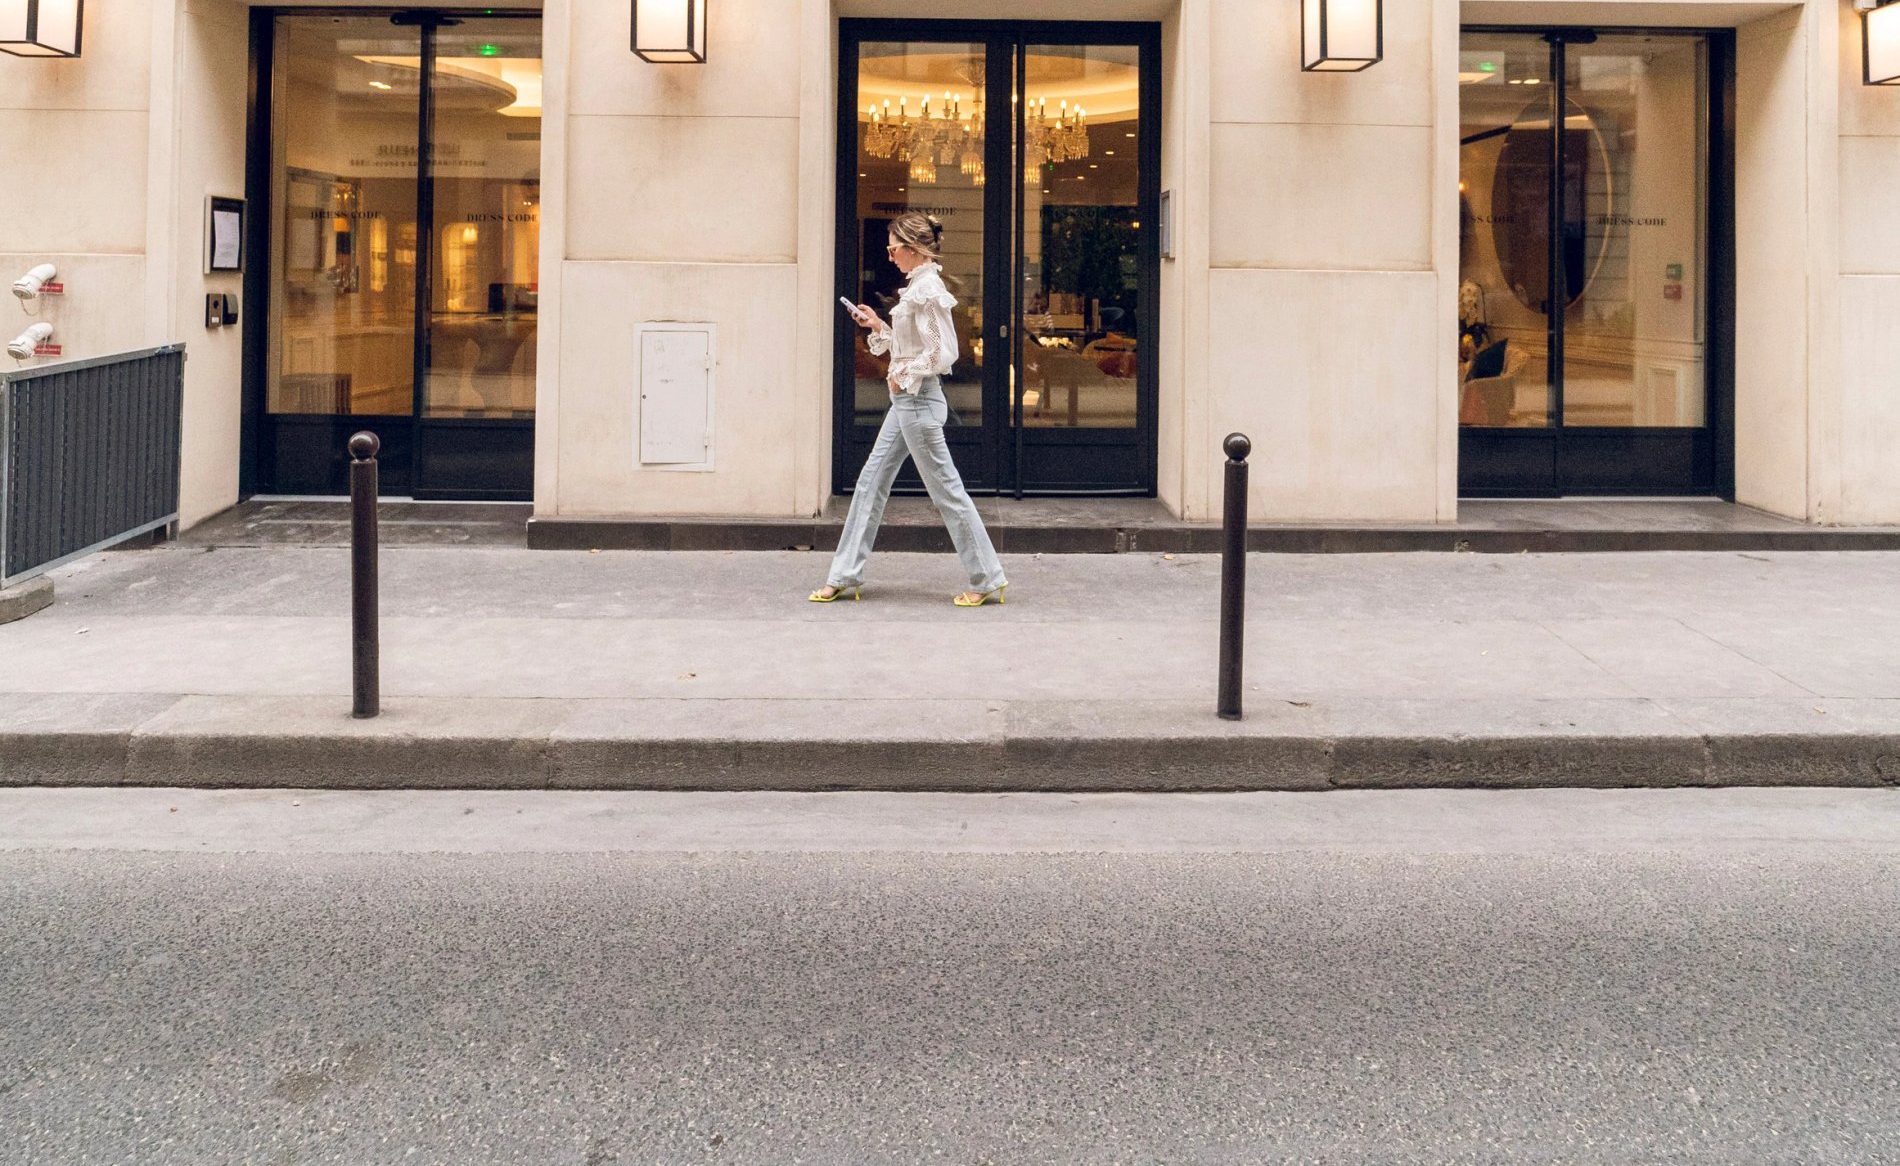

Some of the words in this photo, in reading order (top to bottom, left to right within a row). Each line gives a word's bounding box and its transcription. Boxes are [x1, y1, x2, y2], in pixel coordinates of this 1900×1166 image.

[310, 210, 348, 220] DRESS
[350, 210, 383, 220] CODE
[925, 207, 956, 216] CODE
[466, 213, 504, 222] DRESS
[1637, 218, 1668, 227] CODE
